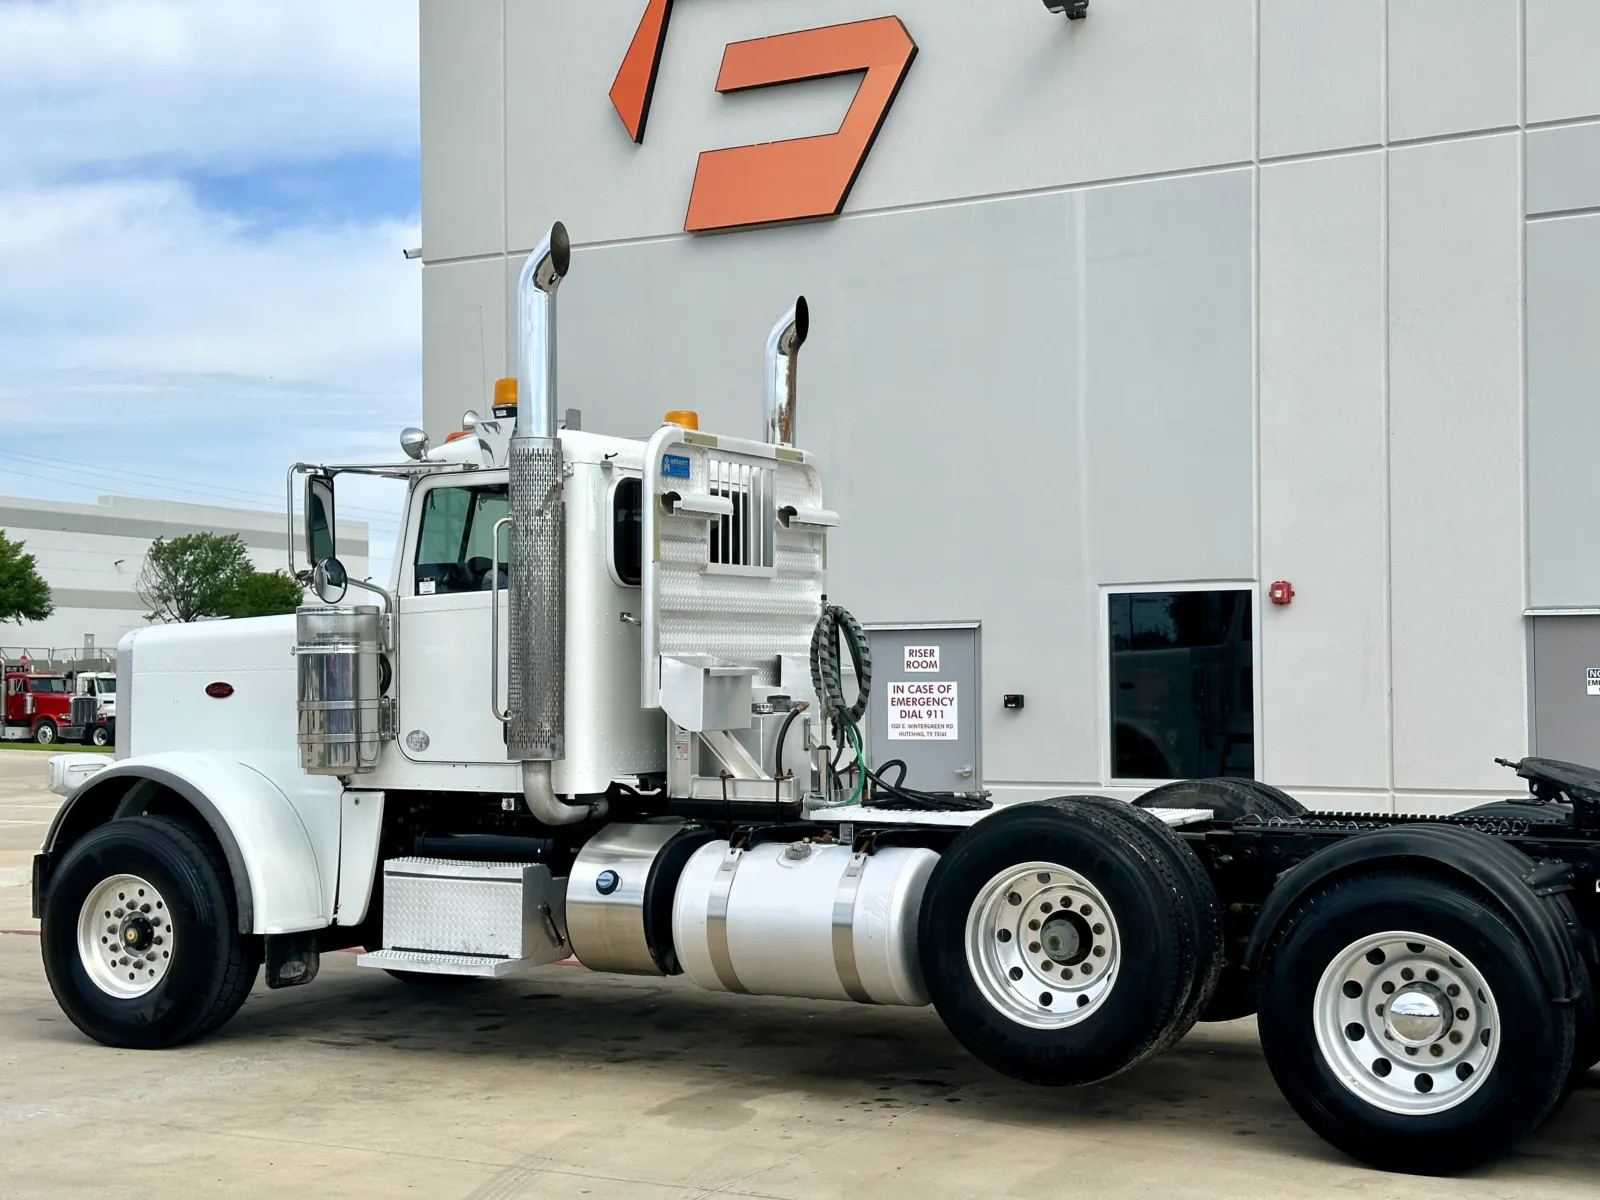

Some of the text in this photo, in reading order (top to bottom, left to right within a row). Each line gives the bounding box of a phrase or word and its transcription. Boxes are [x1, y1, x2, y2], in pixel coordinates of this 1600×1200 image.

[908, 648, 935, 658] RISER
[906, 660, 938, 669] ROOM
[893, 684, 952, 694] IN CASE OF
[891, 697, 954, 707] EMERGENCY
[900, 709, 944, 719] DIAL 911
